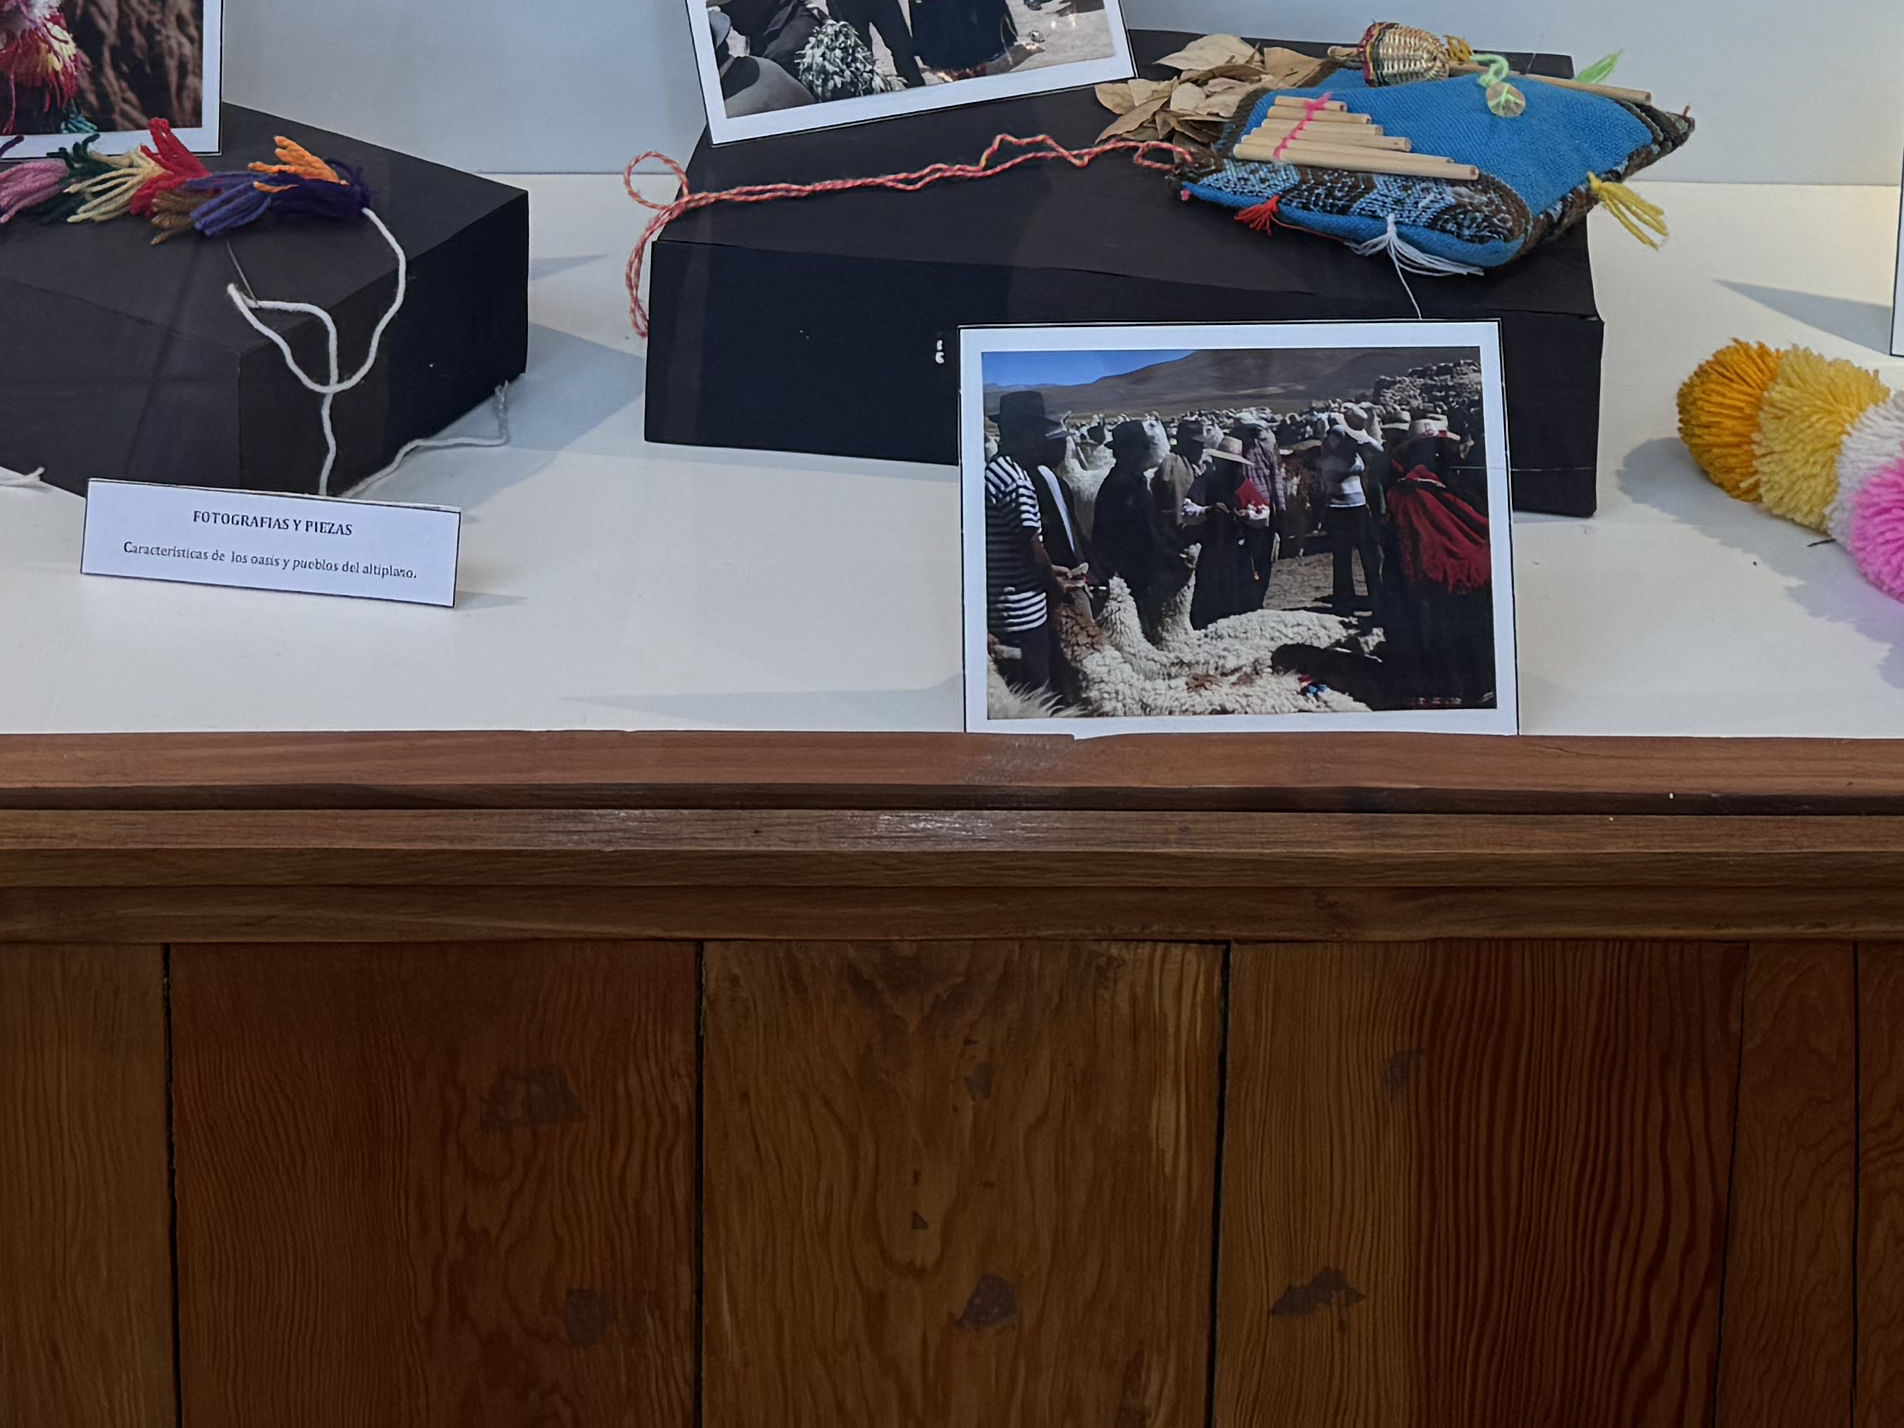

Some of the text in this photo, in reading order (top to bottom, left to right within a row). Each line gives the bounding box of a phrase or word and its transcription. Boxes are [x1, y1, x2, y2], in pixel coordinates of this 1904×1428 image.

[191, 509, 353, 537] FOTOGRAFIAS Y PIEZAS
[122, 539, 209, 560] Características
[210, 547, 226, 562] de
[229, 549, 248, 564] los
[249, 553, 281, 567] oasis
[280, 557, 291, 571] y
[290, 556, 340, 572] pueblos
[340, 559, 360, 574] del
